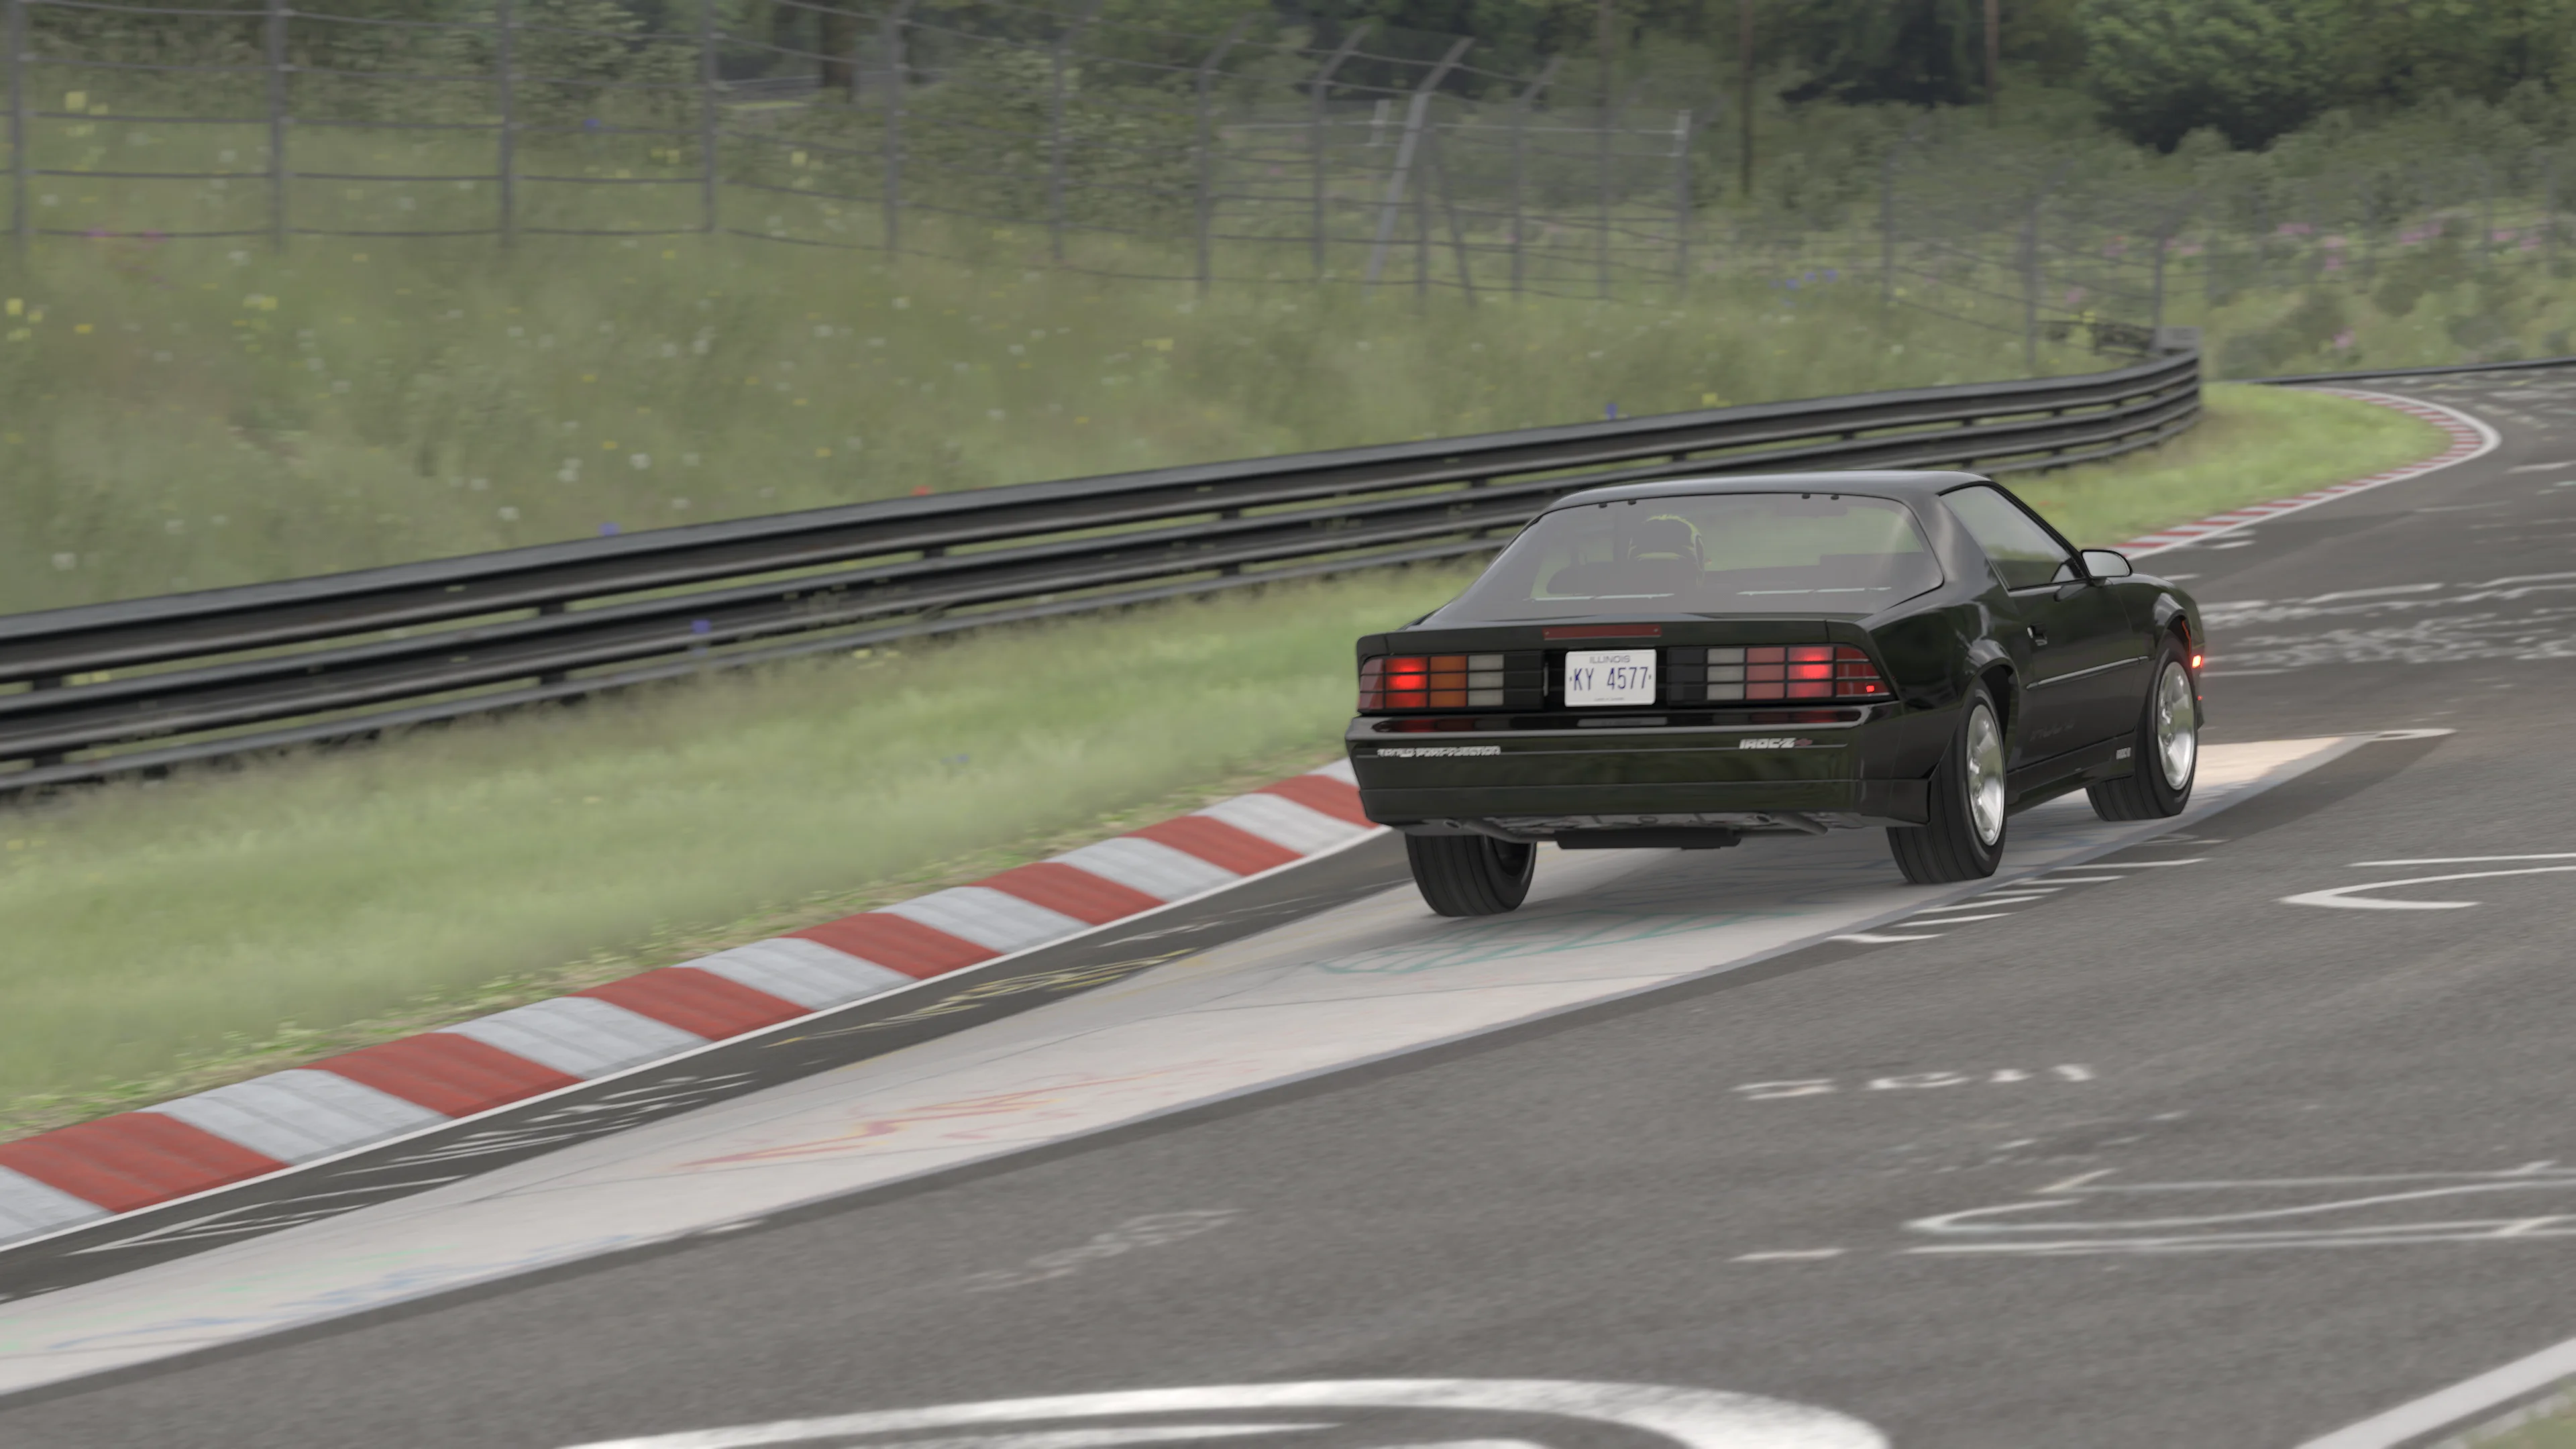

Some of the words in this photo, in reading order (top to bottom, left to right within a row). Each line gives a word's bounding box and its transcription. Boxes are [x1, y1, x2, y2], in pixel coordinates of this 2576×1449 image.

[1589, 655, 1631, 663] ILLINOIS
[1574, 667, 1595, 691] KY
[1607, 666, 1648, 690] 4577
